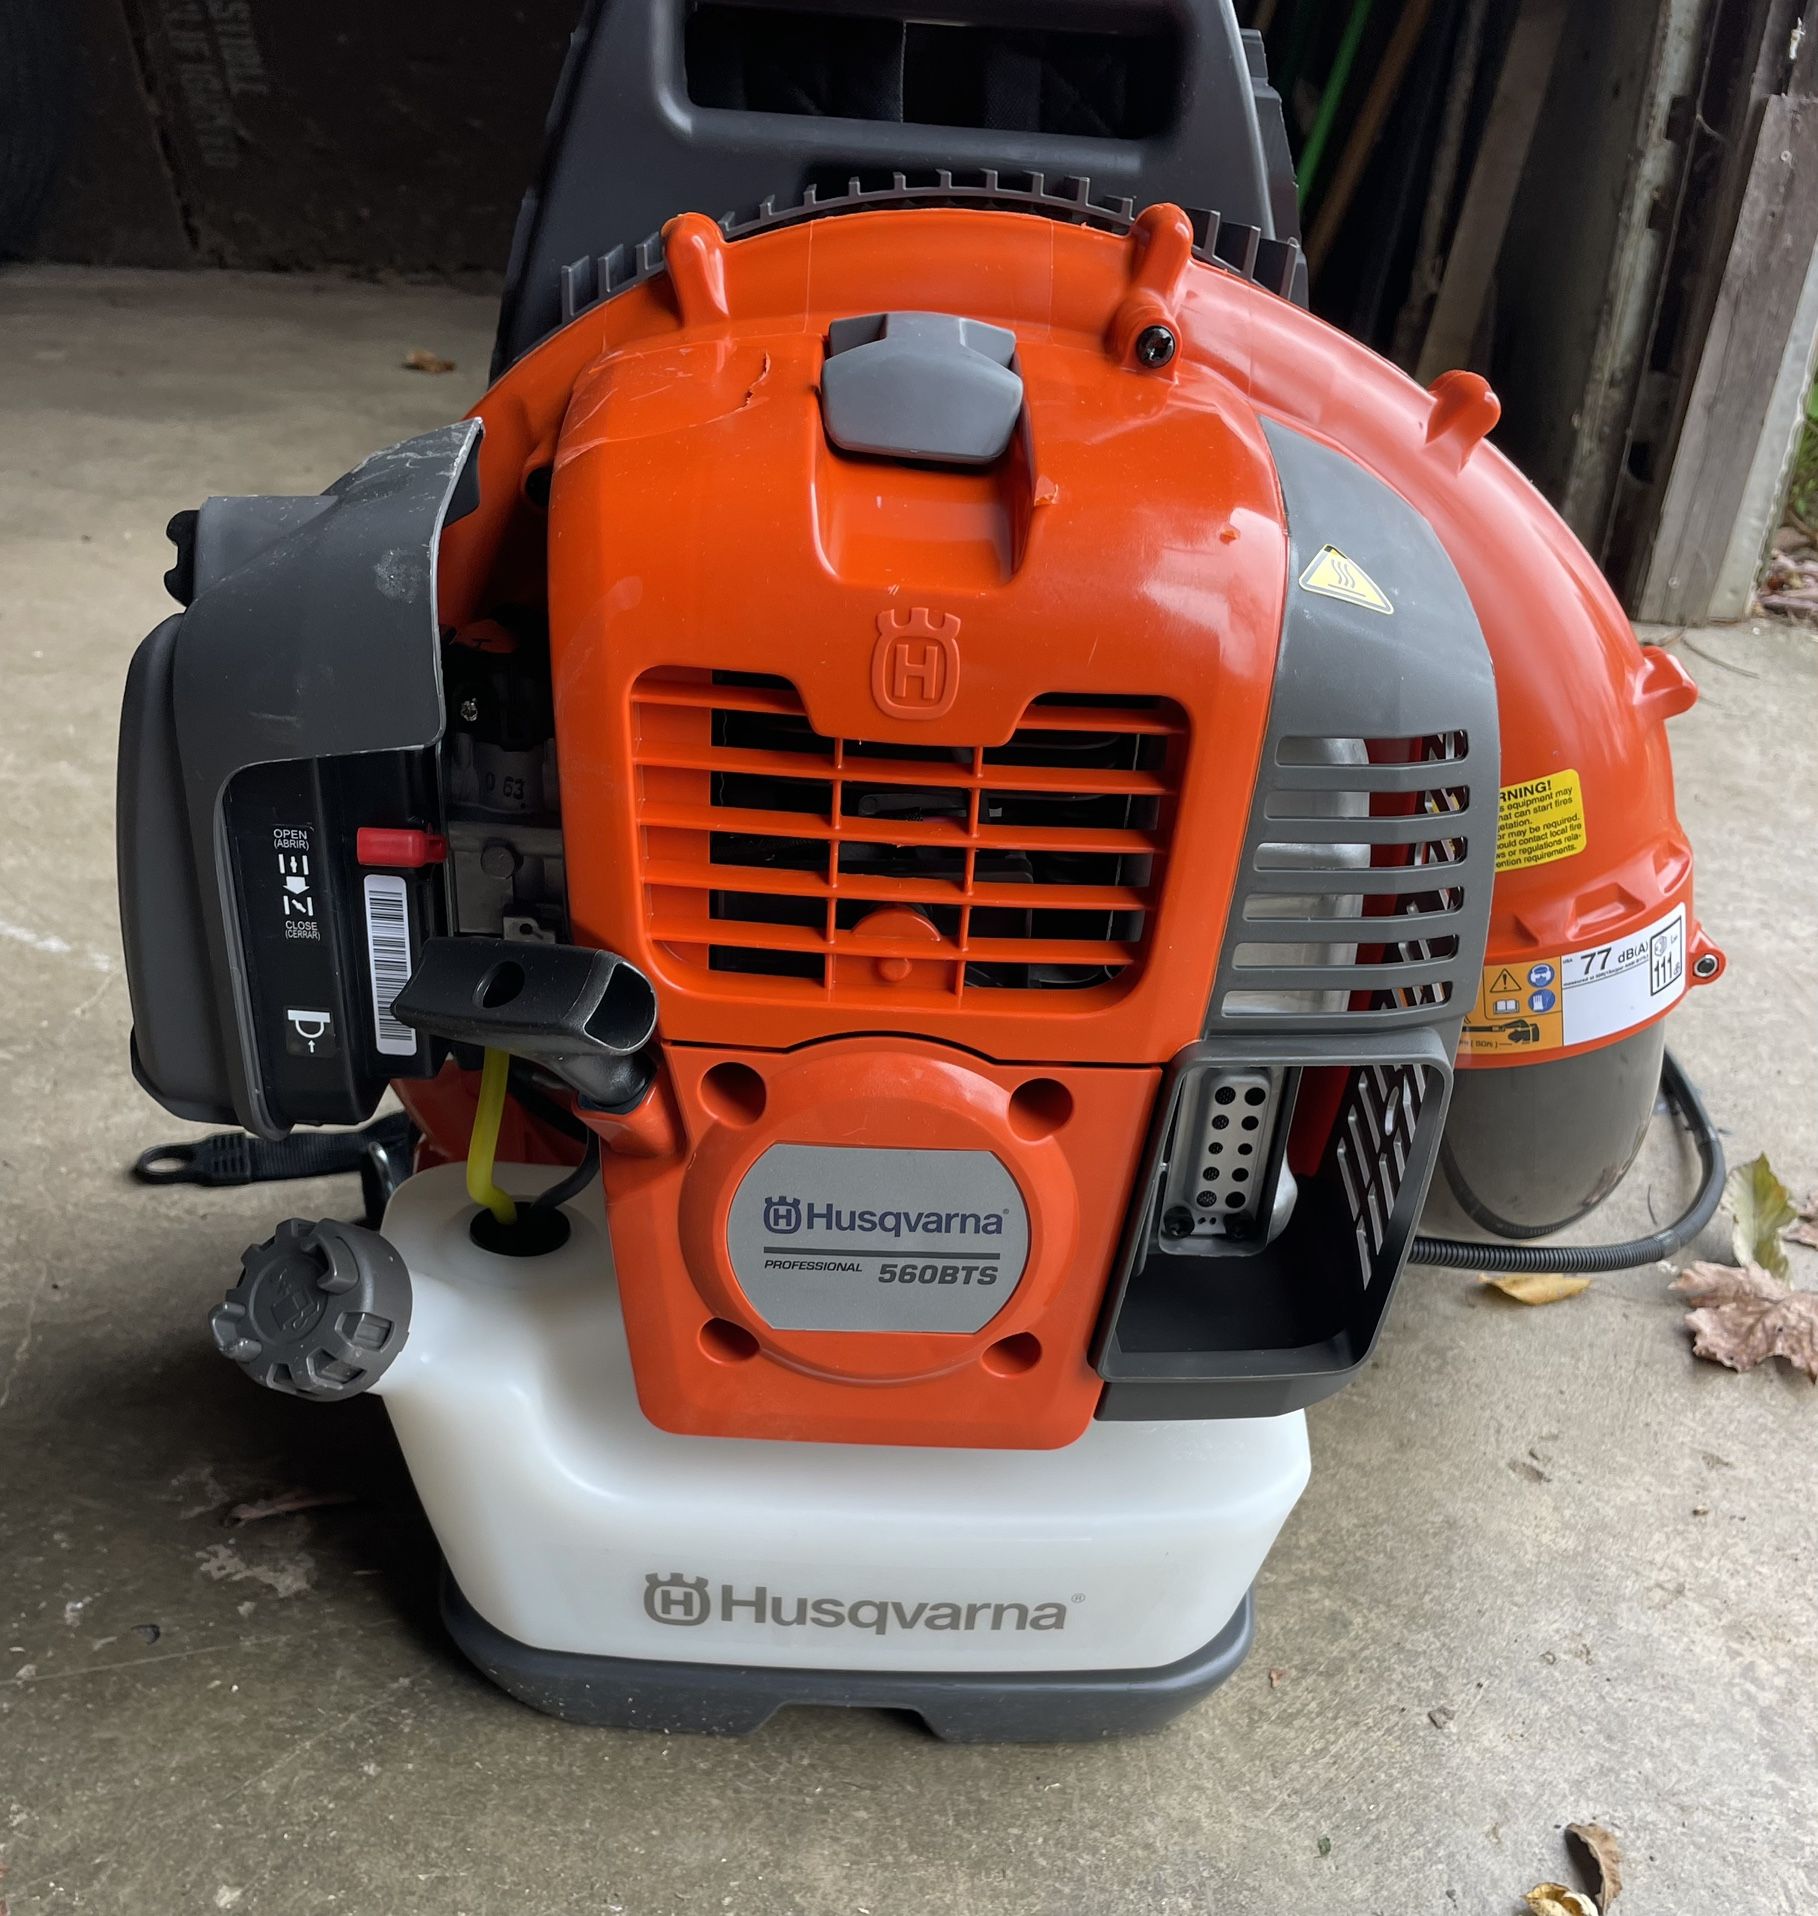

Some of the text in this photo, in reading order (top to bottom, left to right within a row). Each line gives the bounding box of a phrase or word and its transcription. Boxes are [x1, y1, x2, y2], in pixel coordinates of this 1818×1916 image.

[1500, 780, 1552, 802] RNING!
[1507, 792, 1553, 811] equipment
[1555, 787, 1573, 798] may
[1514, 809, 1531, 818] can
[1533, 802, 1553, 814] start
[1555, 797, 1573, 807] fires
[273, 828, 308, 840] OPEN
[1497, 839, 1516, 850] ould
[1519, 832, 1548, 845] contact
[1550, 826, 1567, 837] local
[1569, 822, 1581, 832] fire
[1498, 818, 1532, 832] etation.
[1508, 829, 1527, 839] may
[1529, 825, 1540, 834] be
[1543, 813, 1581, 830] required.
[274, 839, 310, 851] (ABRIR)
[1496, 844, 1577, 868] ention requirements.
[1508, 849, 1516, 857] or
[1519, 838, 1562, 855] regulations
[285, 920, 318, 931] CLOSE
[285, 930, 321, 941] (CERRAR)
[1580, 947, 1612, 976] 77
[1618, 939, 1649, 964] dB(A)
[1654, 951, 1672, 988] 111
[806, 1202, 1004, 1238] Husqvarna
[764, 1259, 999, 1286] PROFESSIONAL 560BTS
[720, 1584, 1068, 1636] Husqvarna
